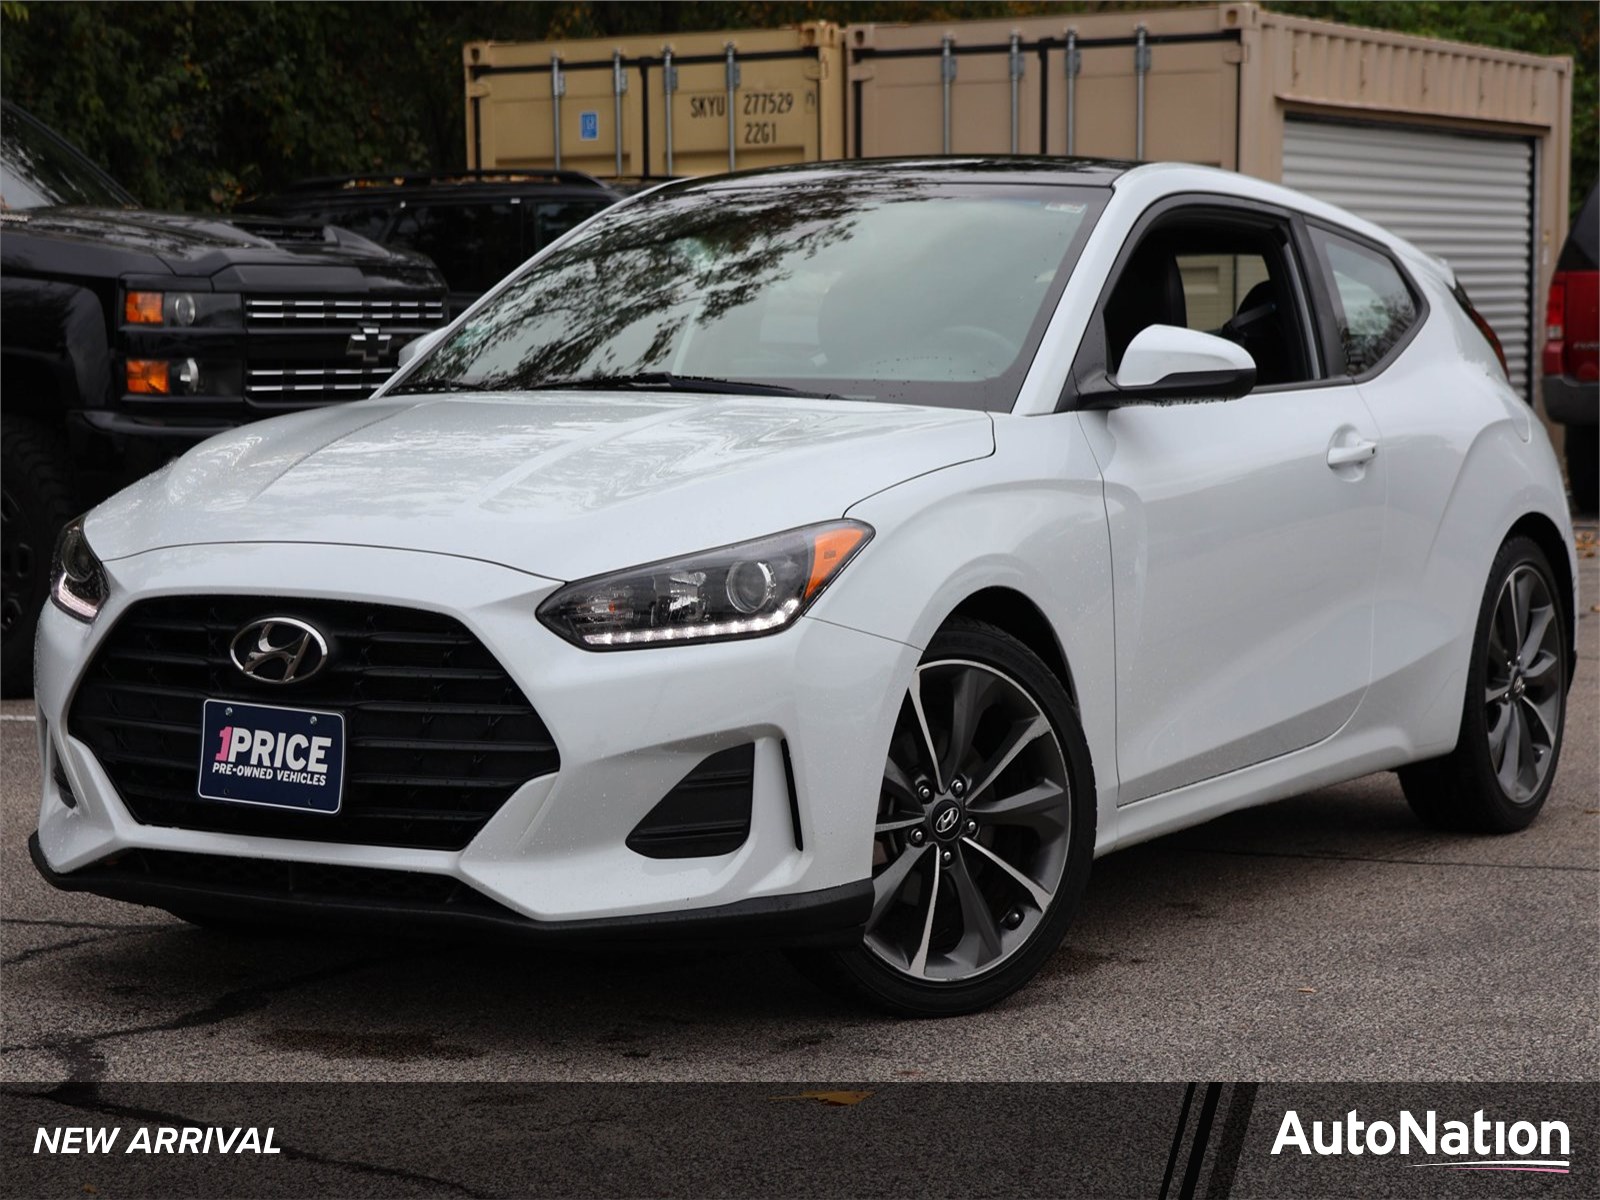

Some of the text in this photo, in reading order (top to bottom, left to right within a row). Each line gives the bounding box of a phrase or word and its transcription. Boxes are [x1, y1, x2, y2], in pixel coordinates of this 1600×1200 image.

[690, 95, 725, 118] SKYU
[744, 92, 793, 115] 277529
[744, 121, 777, 144] 22G1
[215, 725, 332, 773] 1PRICE
[212, 762, 327, 786] PRE-OWNED VEHICLES
